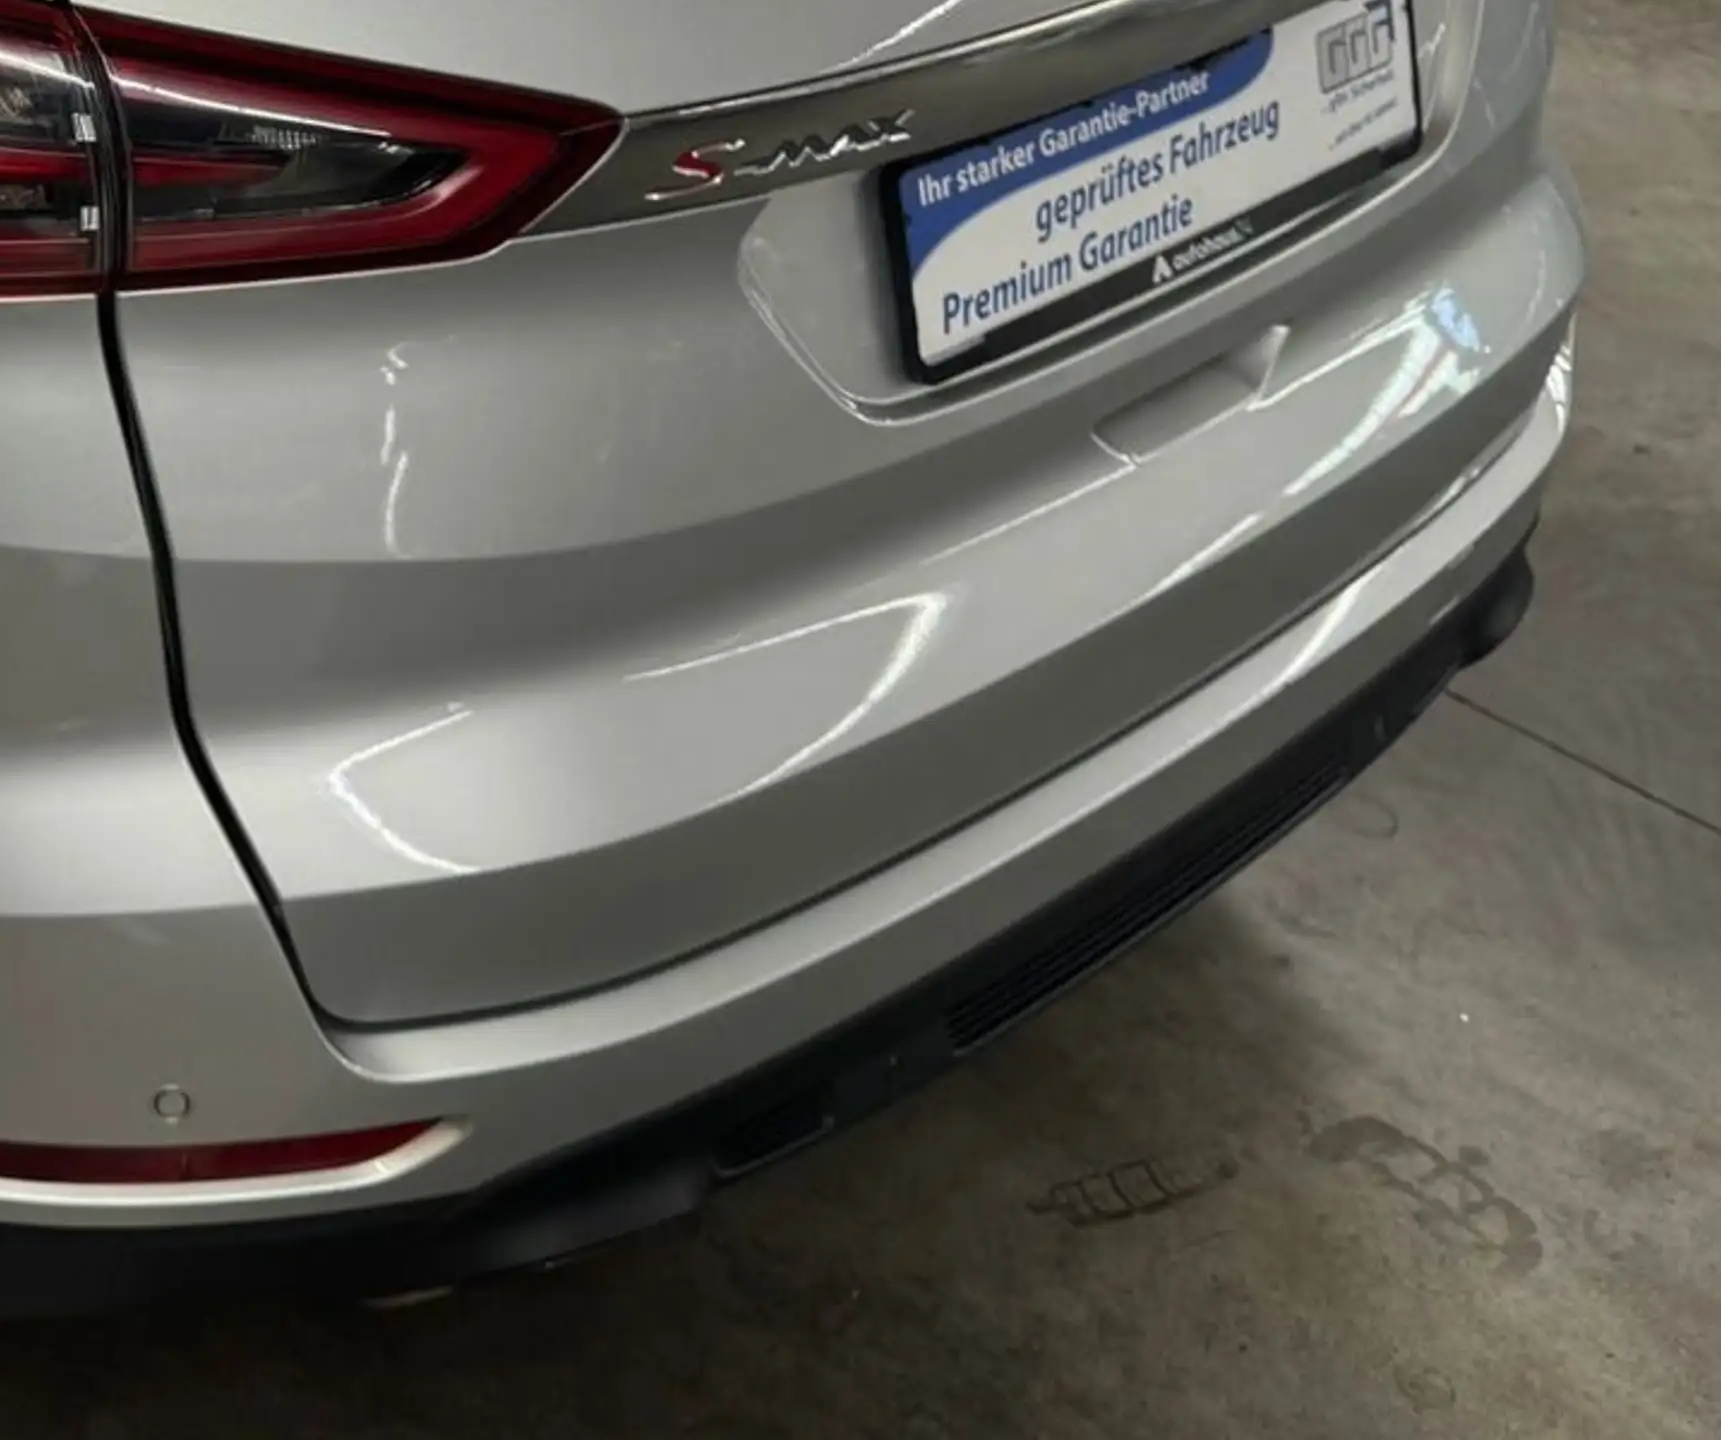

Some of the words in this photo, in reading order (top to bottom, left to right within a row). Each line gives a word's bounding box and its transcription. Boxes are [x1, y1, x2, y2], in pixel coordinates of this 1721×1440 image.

[644, 108, 915, 200] S-MAX
[916, 173, 953, 208] Ihr
[955, 145, 1036, 193] starker
[1038, 71, 1210, 158] Garantie-Partner
[1036, 153, 1165, 244] geprüftes
[1169, 100, 1280, 174] Fahrzeug
[942, 260, 1073, 336] Premium
[1079, 193, 1194, 272] Garantie
